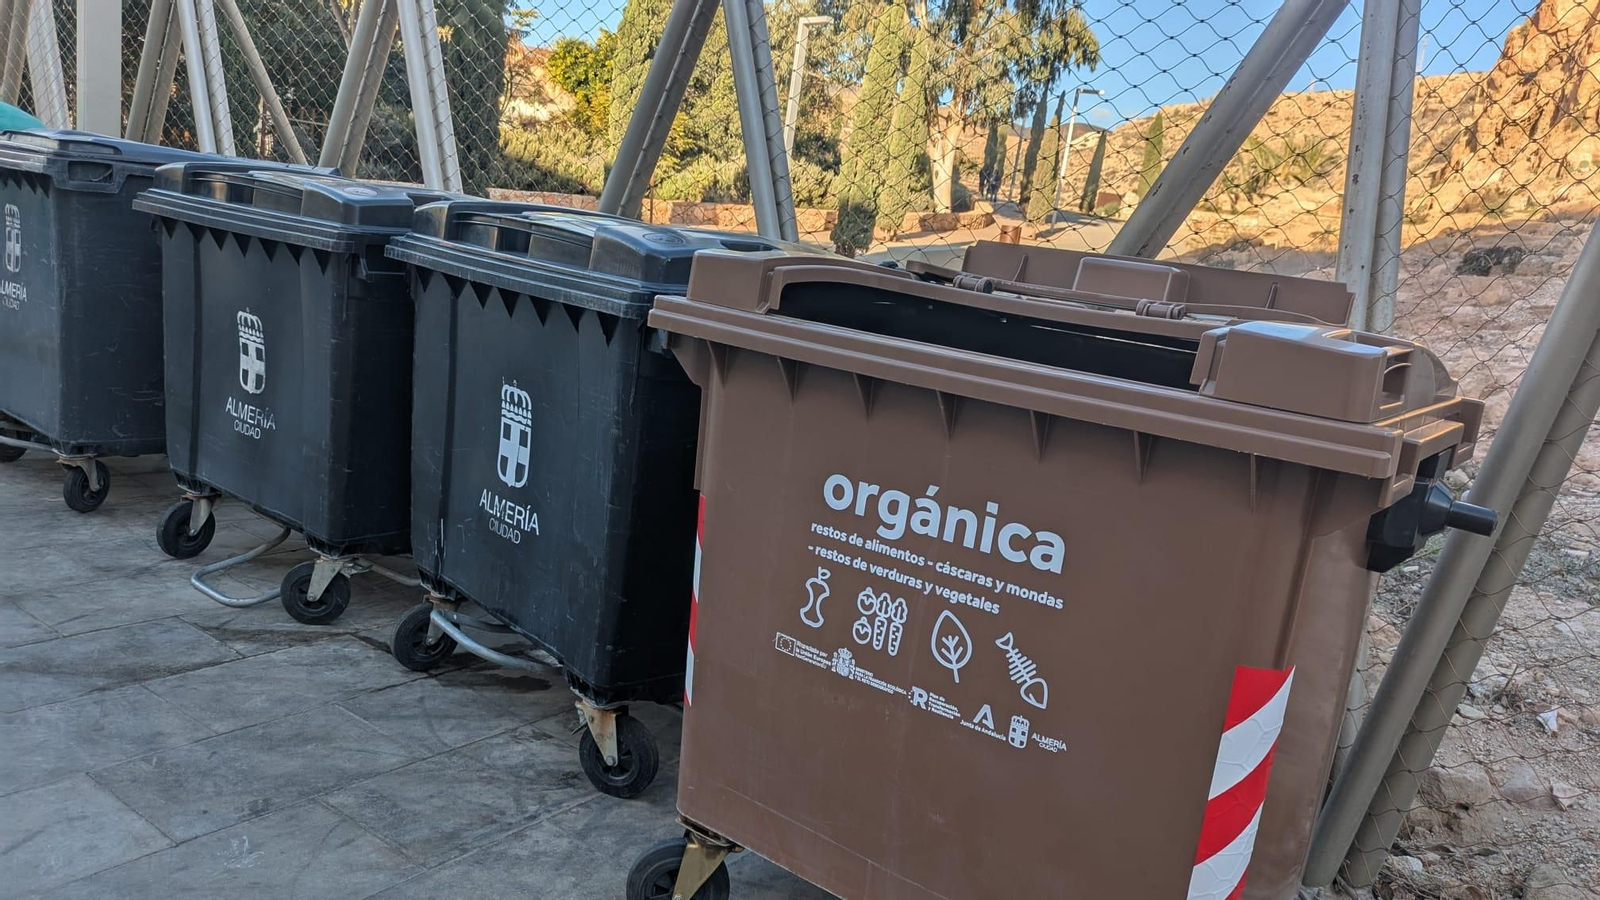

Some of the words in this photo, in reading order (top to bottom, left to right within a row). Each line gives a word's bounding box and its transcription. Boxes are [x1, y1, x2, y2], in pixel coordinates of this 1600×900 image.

[225, 396, 276, 430] ALMERÍA
[234, 419, 261, 439] CIUDAD
[479, 488, 540, 536] ALMERÍA
[823, 473, 1066, 574] orgánica
[488, 517, 521, 544] CIUDAD
[810, 521, 847, 542] restos
[848, 532, 864, 549] de
[864, 539, 926, 567] alimentos
[935, 560, 993, 588] cáscaras
[995, 579, 1004, 592] y
[1006, 581, 1065, 610] mondas
[815, 545, 852, 566] restos
[852, 555, 868, 572] de
[869, 563, 923, 590] verduras
[924, 581, 934, 595] y
[935, 585, 1001, 615] vegetales
[959, 719, 975, 731] Junta
[974, 723, 982, 732] de
[981, 727, 1007, 742] Andalucía
[1031, 732, 1067, 752] ALMERÍA
[1038, 742, 1058, 753] CIUDAD
